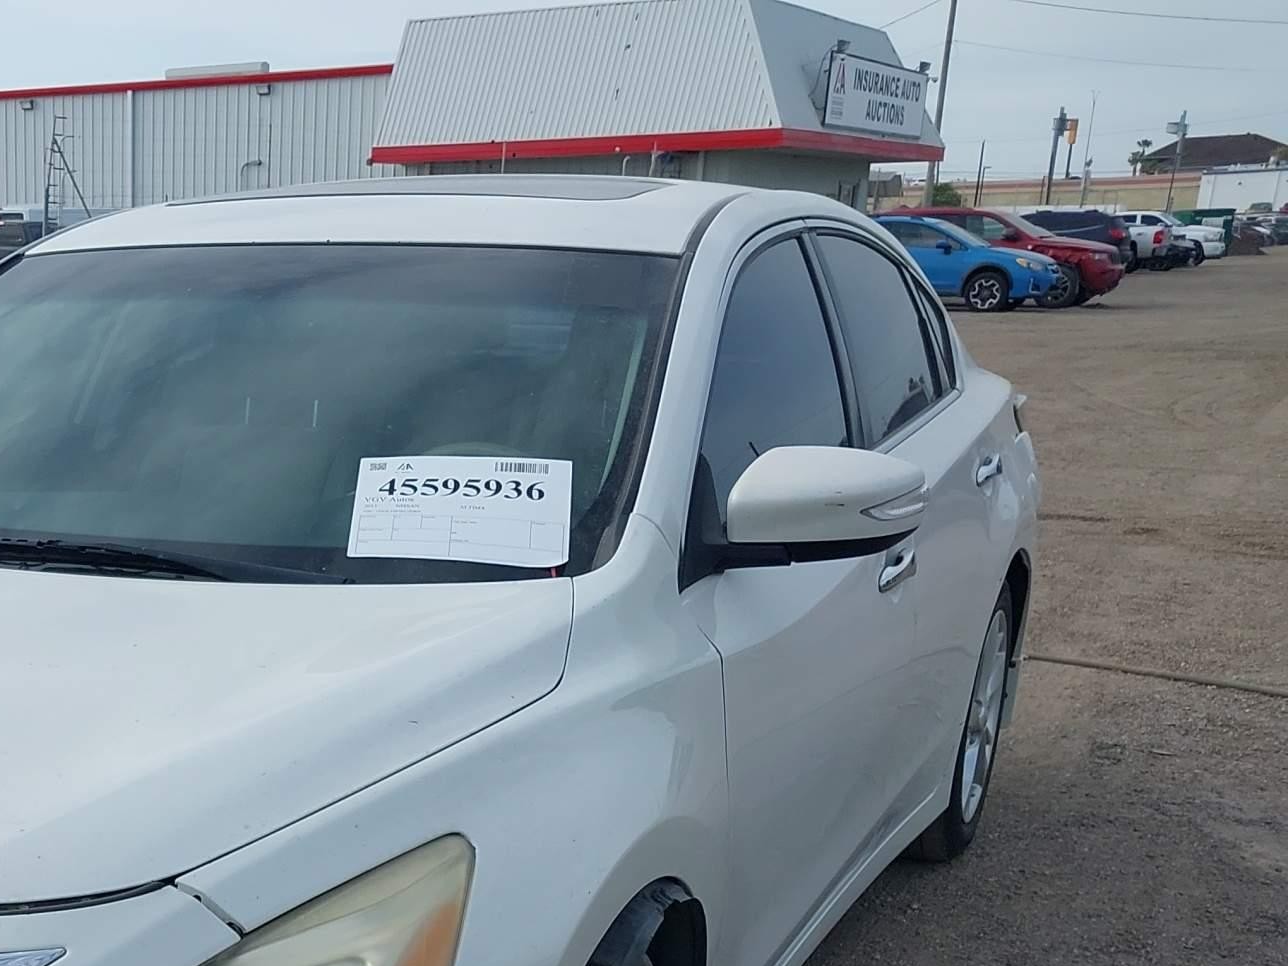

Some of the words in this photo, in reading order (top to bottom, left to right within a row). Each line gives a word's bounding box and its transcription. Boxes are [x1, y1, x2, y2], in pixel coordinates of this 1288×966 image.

[853, 67, 900, 98] INSURANCE
[901, 79, 921, 102] AUTO
[865, 99, 905, 126] AUCTIONS
[378, 477, 546, 501] 45595936
